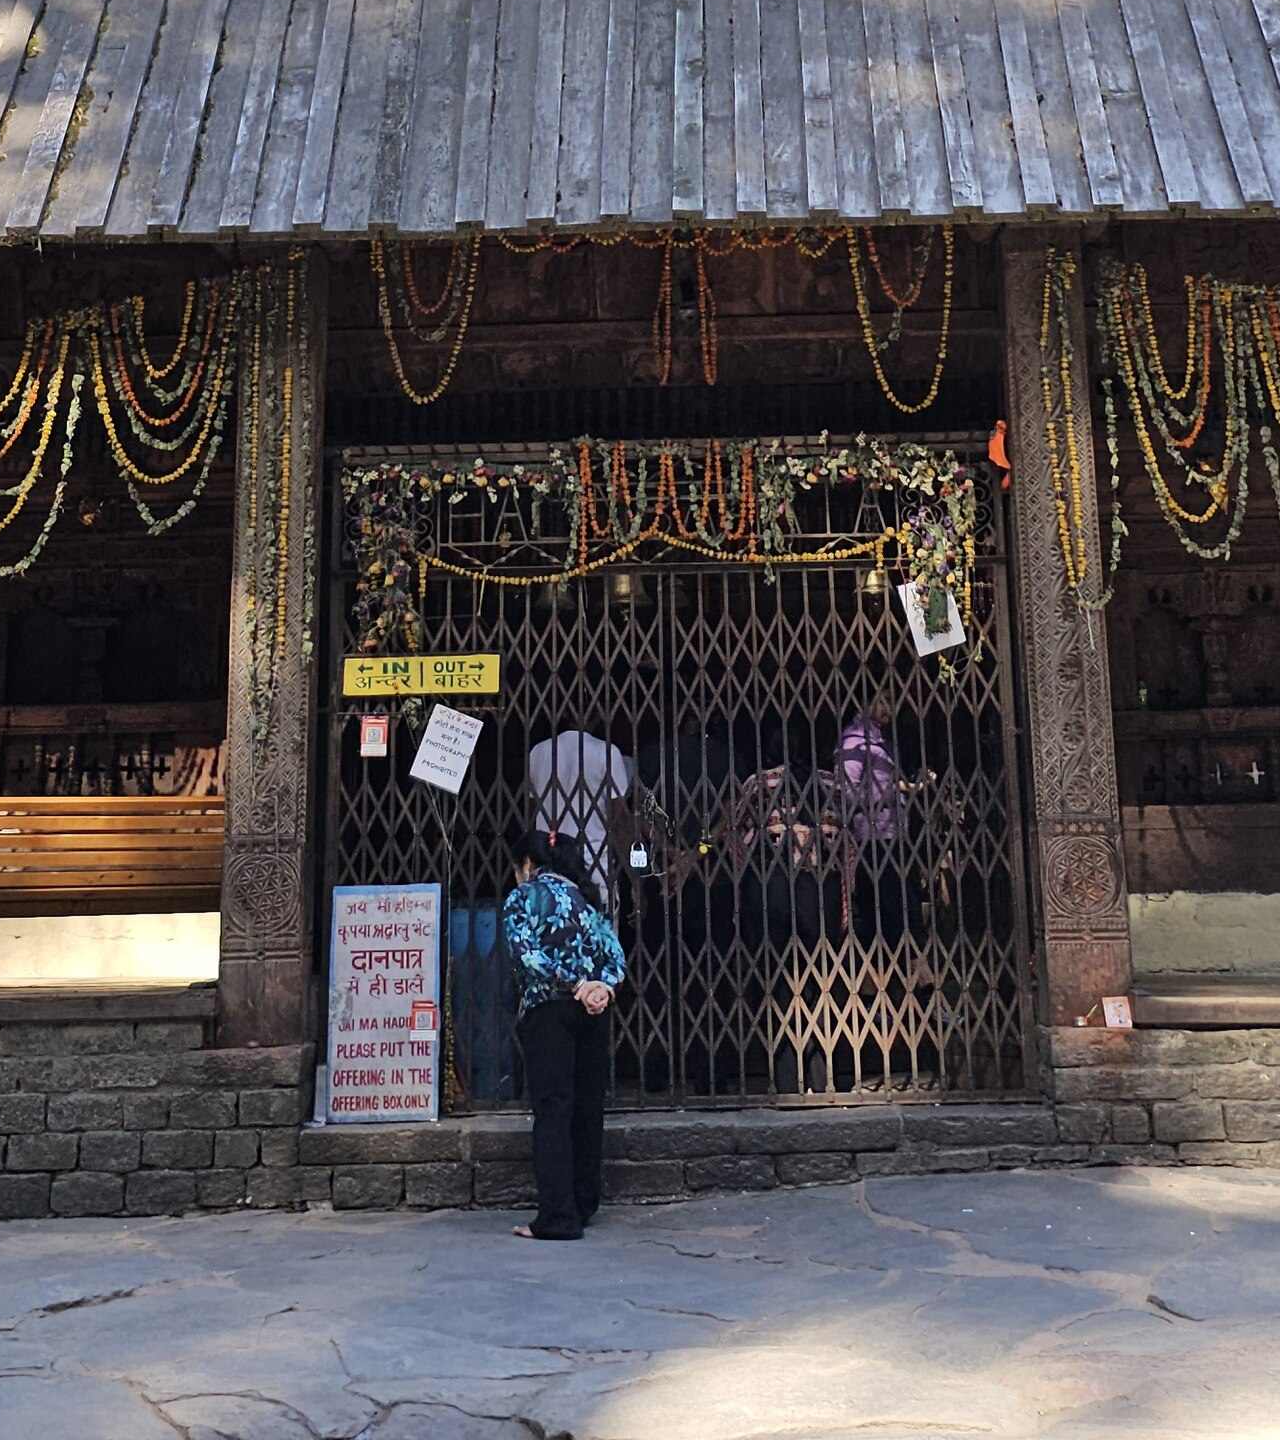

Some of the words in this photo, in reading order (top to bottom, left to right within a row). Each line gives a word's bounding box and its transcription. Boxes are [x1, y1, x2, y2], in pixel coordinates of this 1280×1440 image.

[382, 661, 410, 674] IN
[433, 660, 466, 673] OUT
[432, 673, 486, 688] बाहर
[439, 754, 447, 762] IS
[421, 758, 458, 778] PROHIBITED
[346, 902, 368, 915] जय
[338, 924, 371, 944] कृपया
[350, 948, 424, 973] दानपात्र
[368, 972, 387, 999] ही
[359, 1017, 378, 1031] MA
[336, 1043, 377, 1059] PLEASE
[380, 1041, 405, 1058] PUT
[408, 1040, 431, 1057] THE
[333, 1069, 385, 1087] OFFERING
[391, 1069, 404, 1085] IN
[408, 1067, 432, 1085] THE
[332, 1095, 379, 1112] OFFERING
[383, 1095, 403, 1110] BOX
[404, 1094, 431, 1109] ONLY
